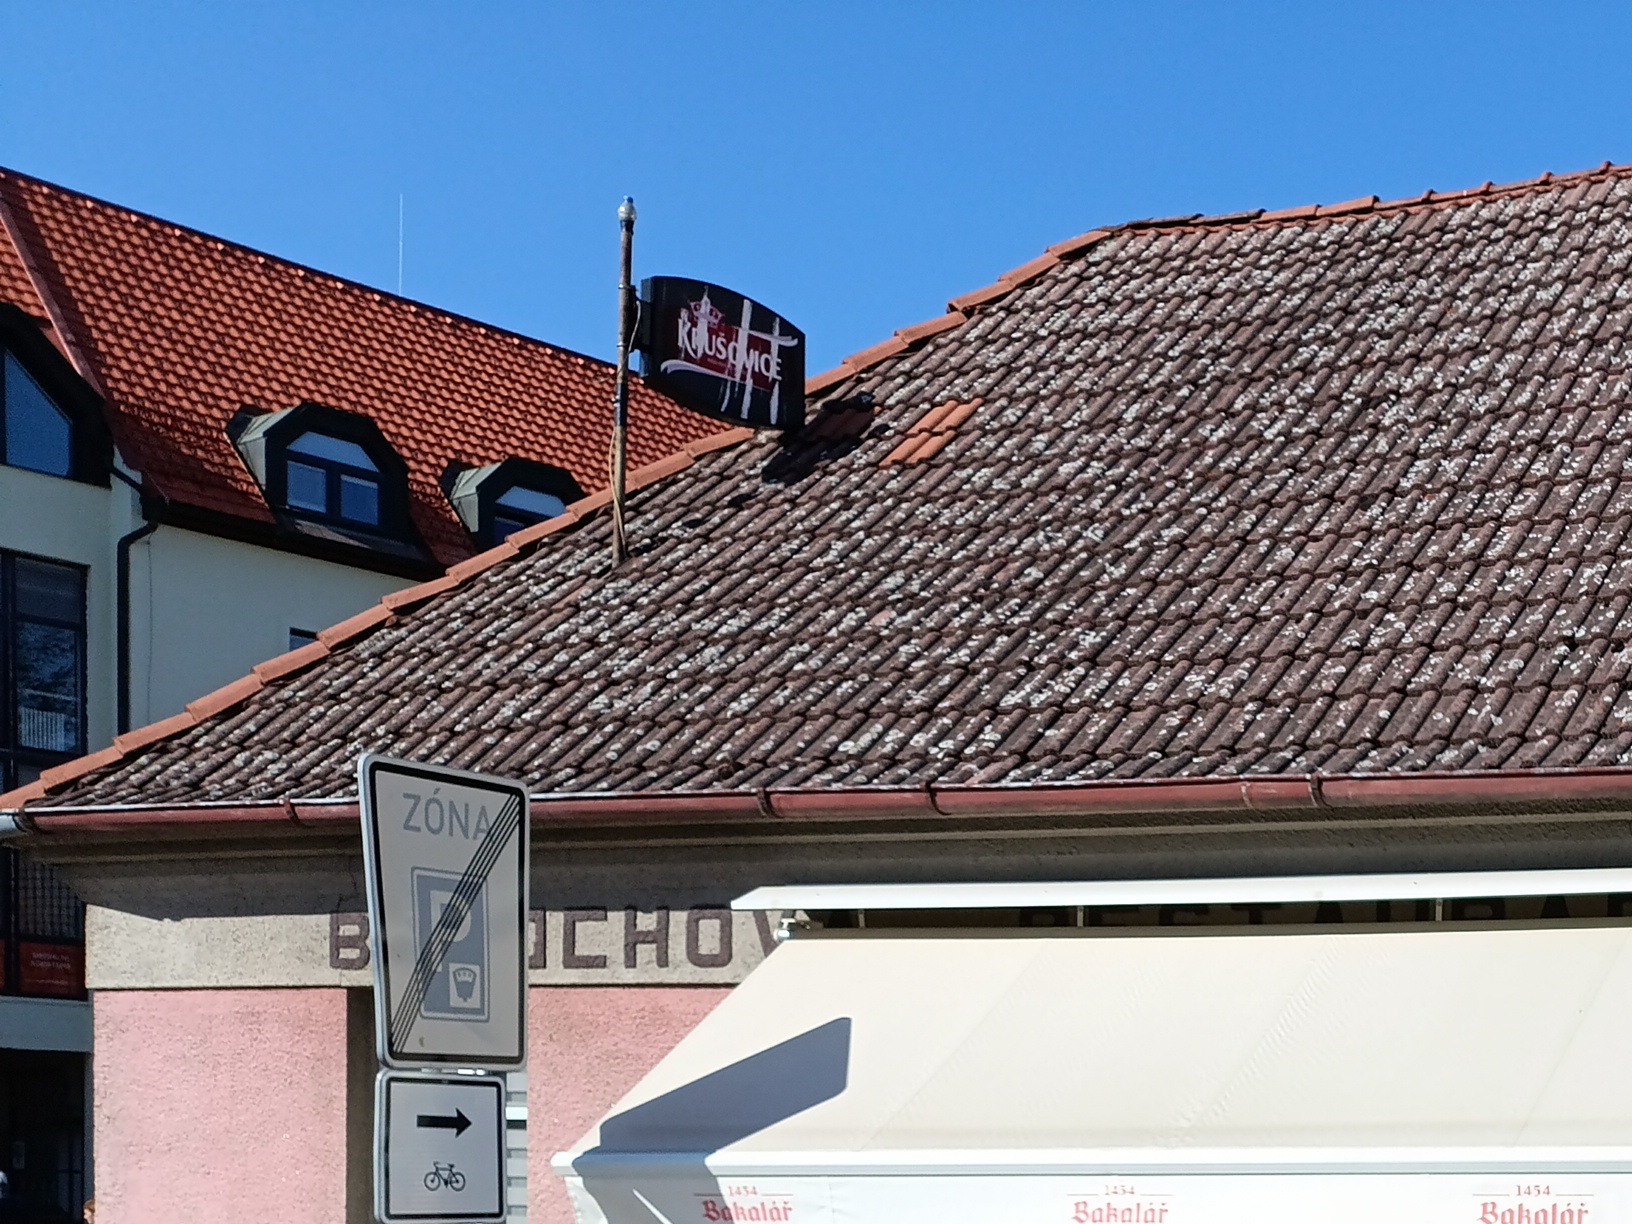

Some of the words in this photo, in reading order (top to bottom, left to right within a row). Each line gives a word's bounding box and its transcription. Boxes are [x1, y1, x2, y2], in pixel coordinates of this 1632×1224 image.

[402, 788, 493, 841] ZÓNA
[1516, 1184, 1551, 1197] 1454
[702, 1200, 793, 1222] Bakalář
[1072, 1200, 1168, 1224] Bakalář
